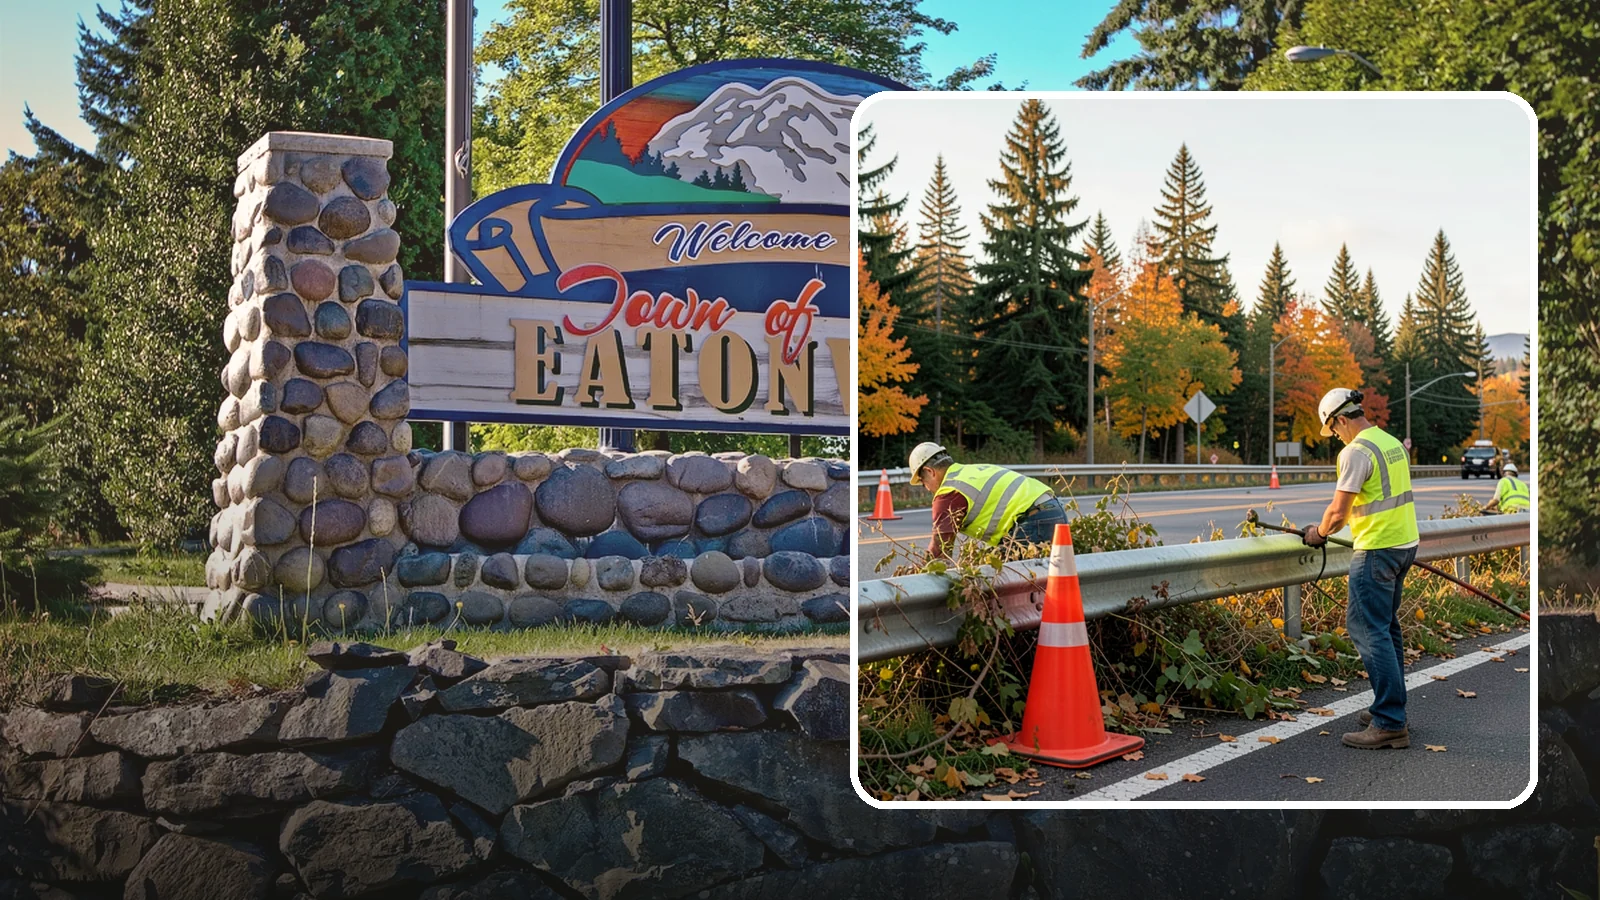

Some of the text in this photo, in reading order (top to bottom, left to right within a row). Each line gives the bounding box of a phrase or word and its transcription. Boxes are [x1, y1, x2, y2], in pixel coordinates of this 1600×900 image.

[653, 221, 837, 264] Welcome
[557, 263, 826, 365] Town of
